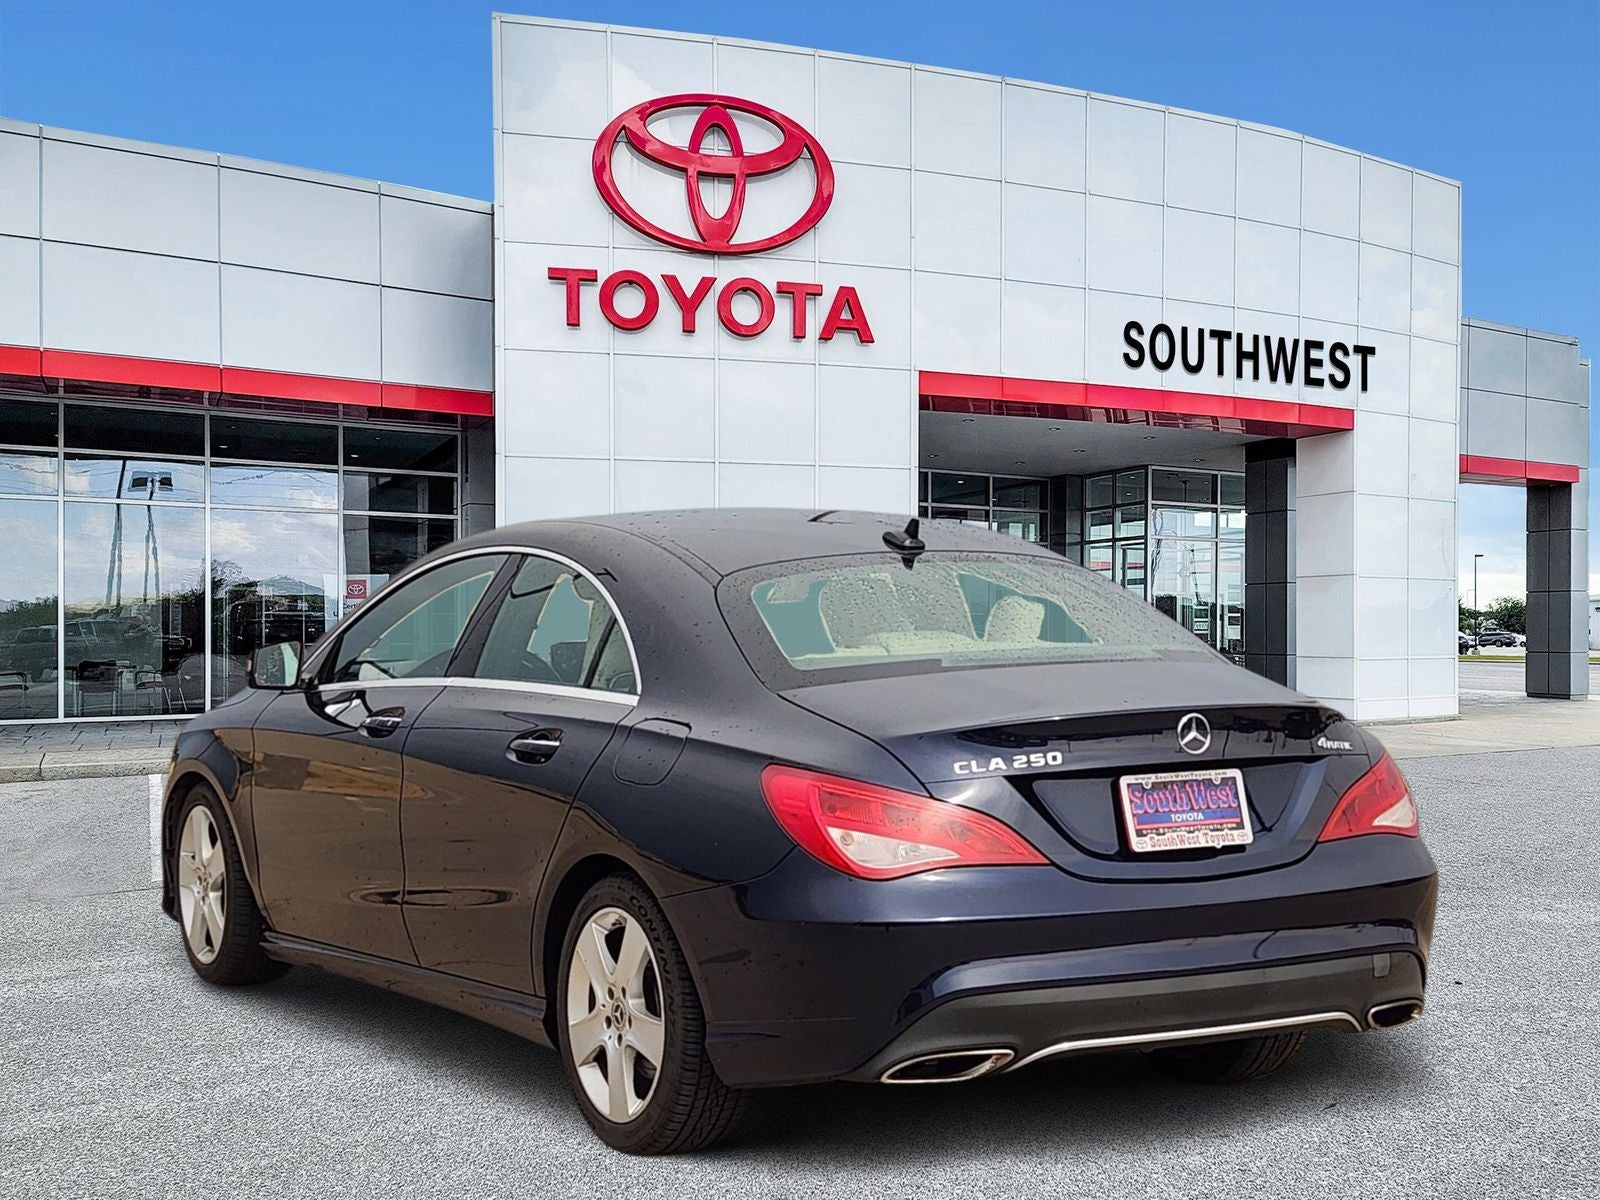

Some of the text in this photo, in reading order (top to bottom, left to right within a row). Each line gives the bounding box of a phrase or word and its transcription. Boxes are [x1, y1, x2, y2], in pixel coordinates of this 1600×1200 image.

[547, 266, 875, 344] TOYOTA
[1122, 320, 1376, 394] SOUTHWEST
[953, 751, 1063, 775] CLA 250
[1128, 781, 1238, 814] SouthWest
[1170, 812, 1205, 822] TOYOTA
[1202, 831, 1236, 845] Toyota
